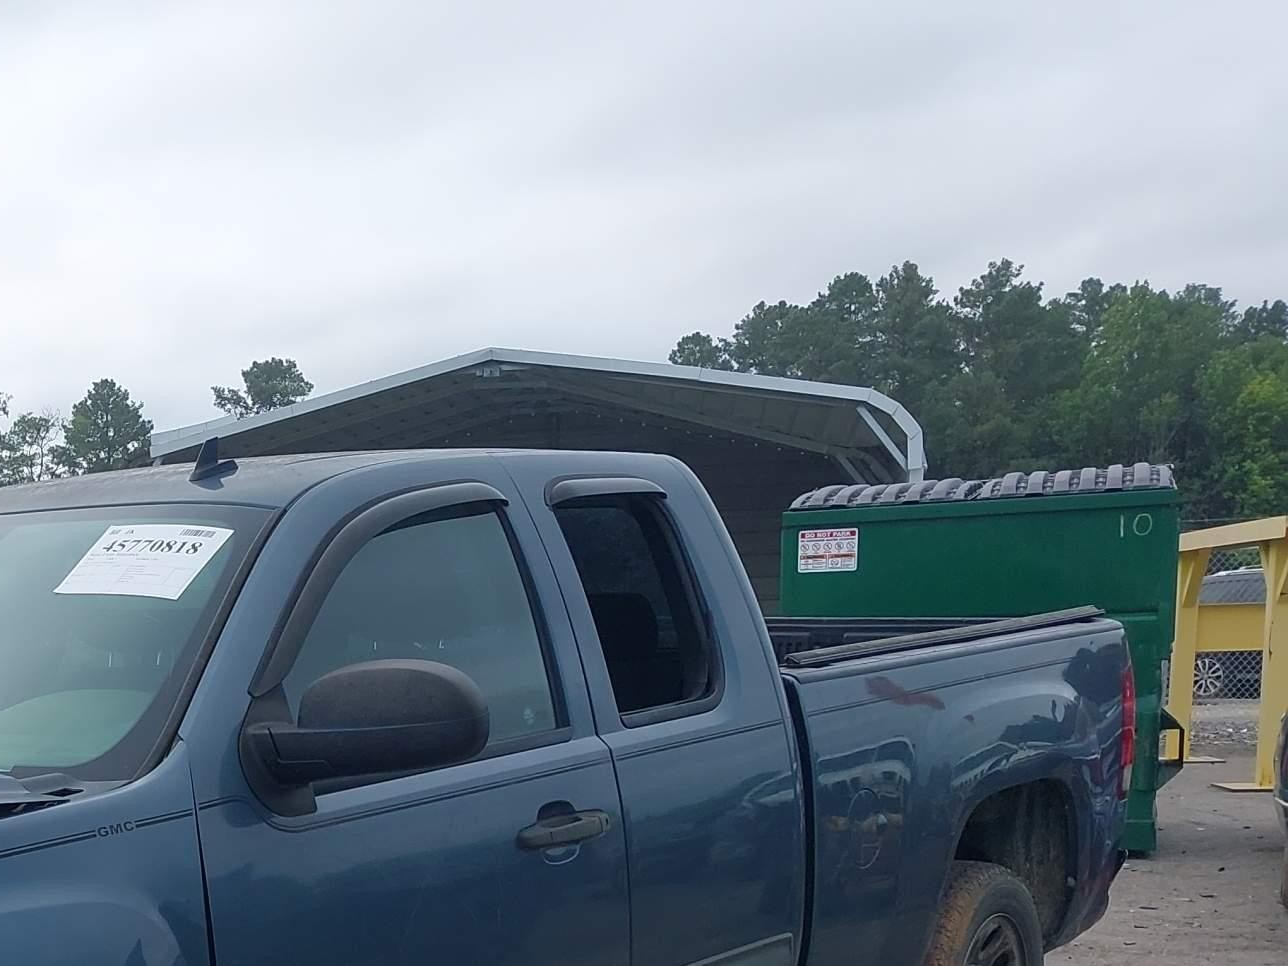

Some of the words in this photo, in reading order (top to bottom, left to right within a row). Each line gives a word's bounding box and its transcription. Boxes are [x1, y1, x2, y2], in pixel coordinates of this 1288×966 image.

[1120, 513, 1153, 538] 10
[102, 538, 204, 555] 45770818
[97, 821, 135, 837] GMC
